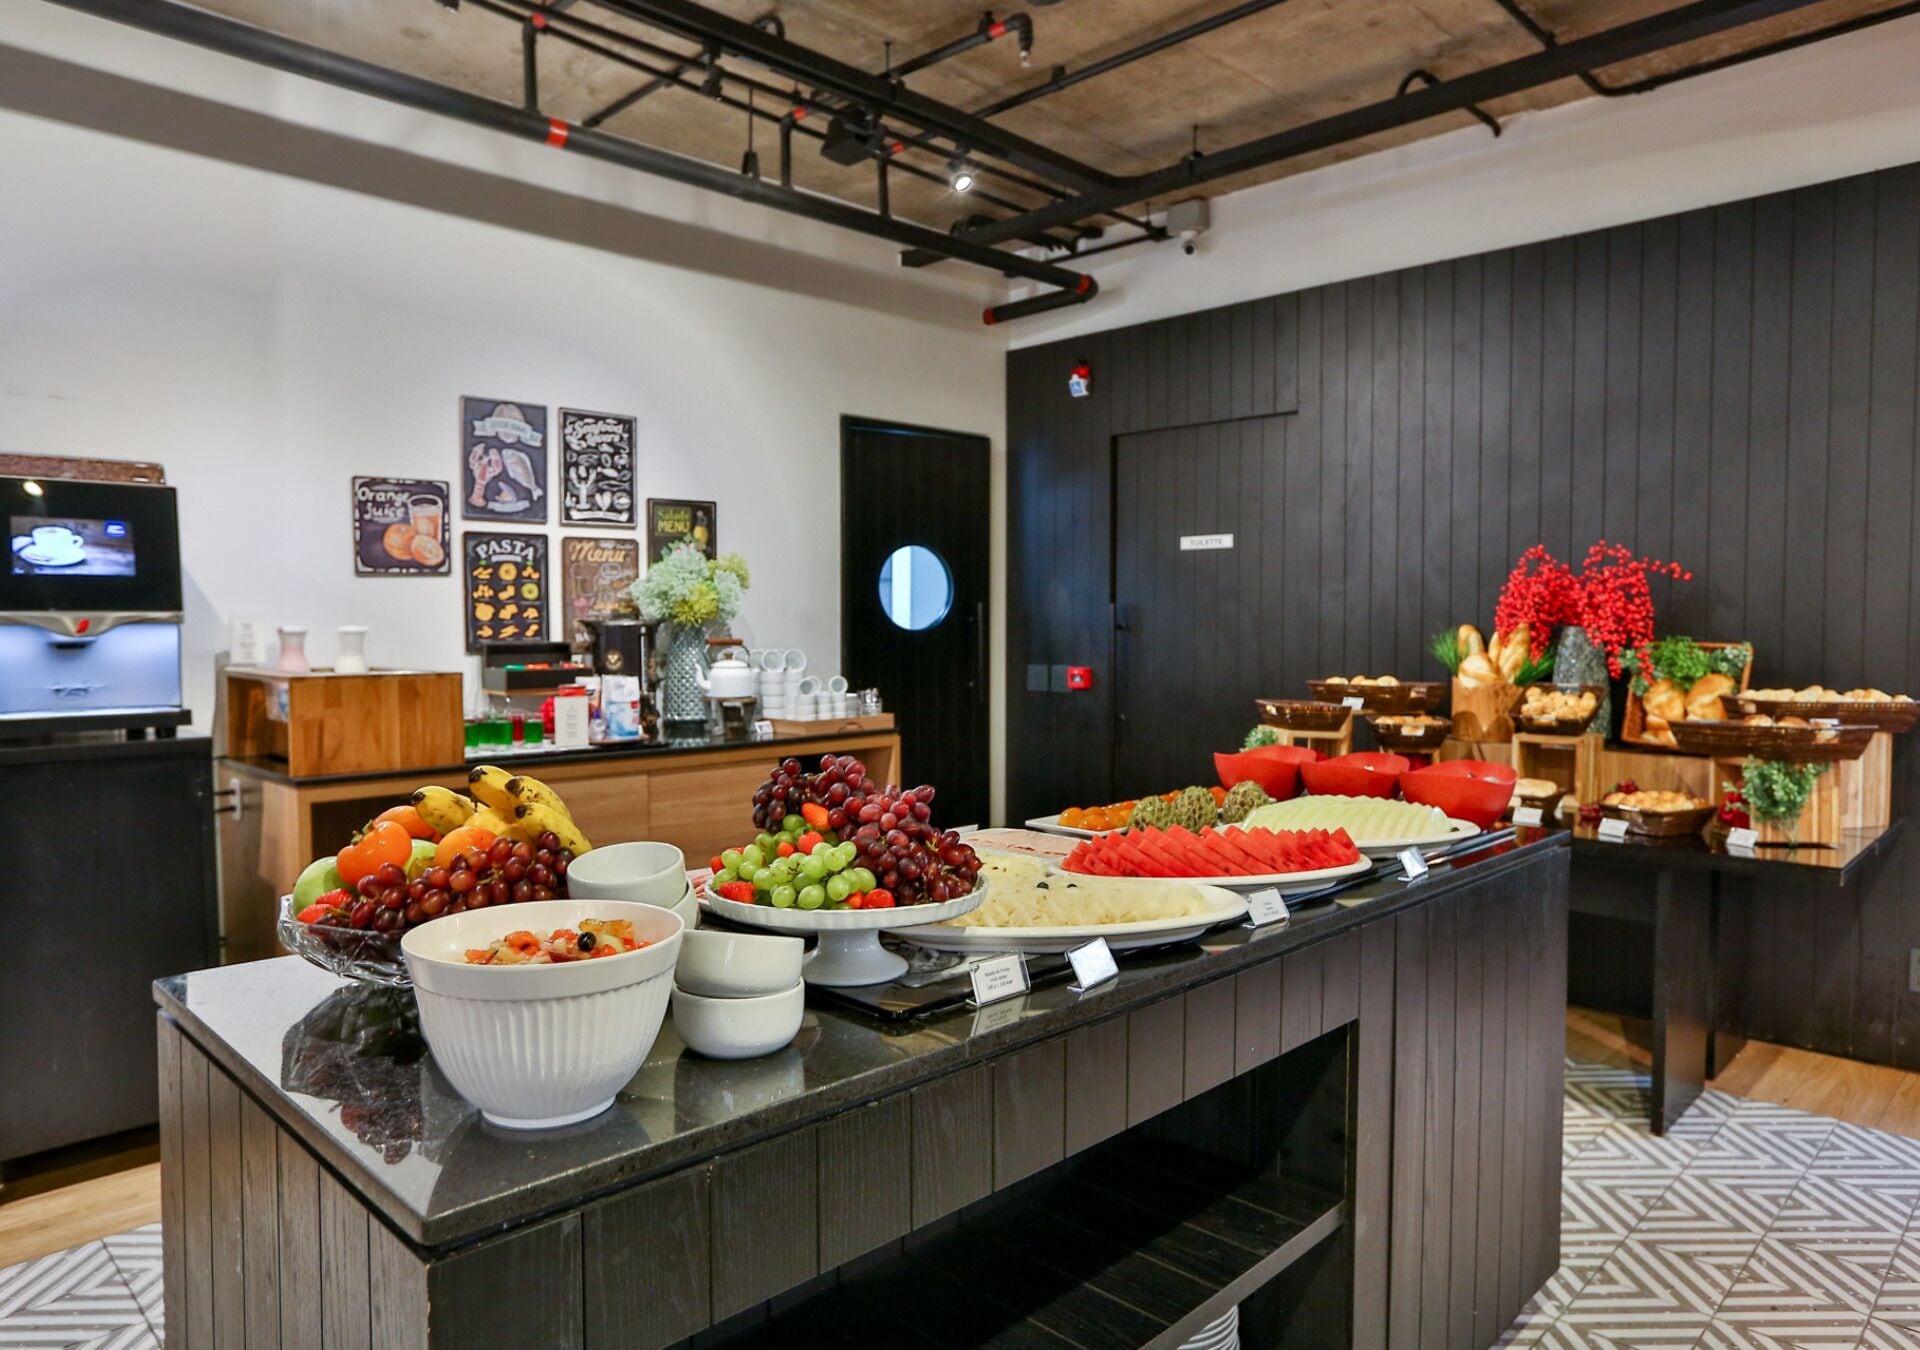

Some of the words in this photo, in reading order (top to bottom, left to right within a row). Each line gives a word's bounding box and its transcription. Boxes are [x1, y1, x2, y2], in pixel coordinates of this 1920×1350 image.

[574, 420, 623, 437] Seafood
[357, 487, 410, 507] Orange
[657, 520, 691, 533] MENU
[475, 539, 536, 561] PASTA
[569, 541, 627, 563] Menu
